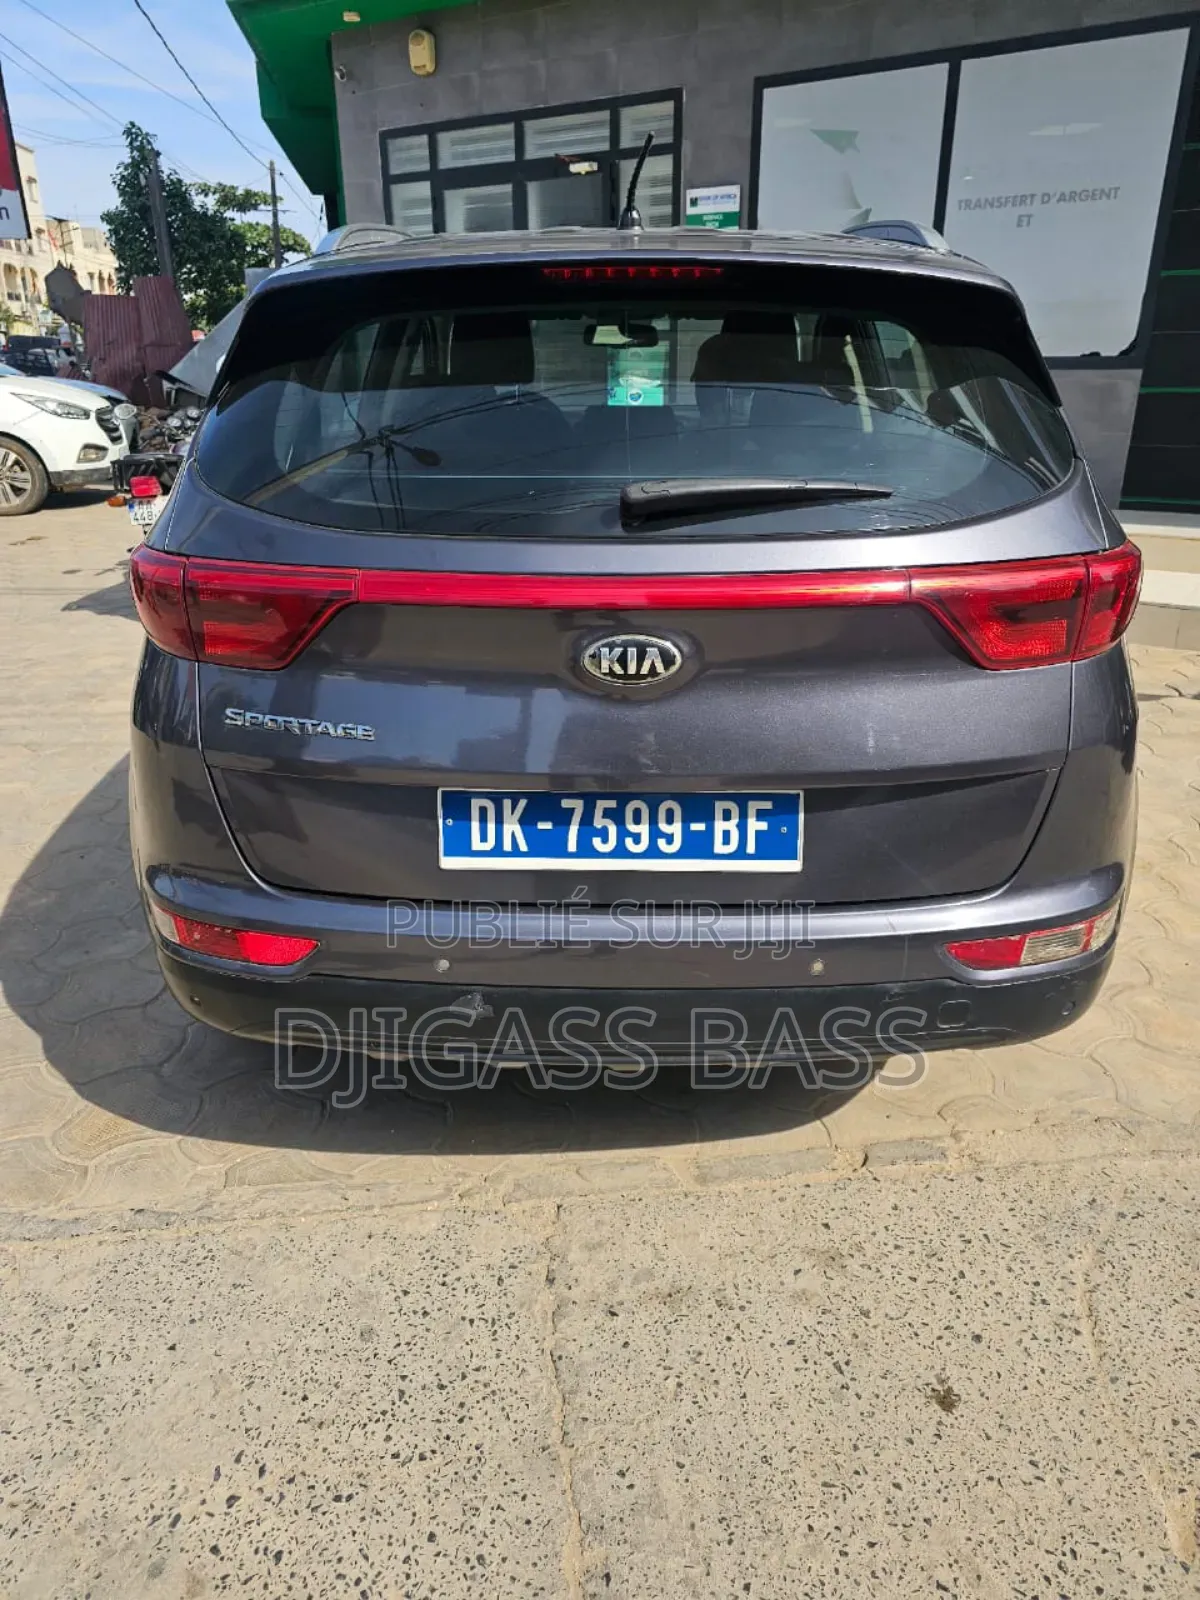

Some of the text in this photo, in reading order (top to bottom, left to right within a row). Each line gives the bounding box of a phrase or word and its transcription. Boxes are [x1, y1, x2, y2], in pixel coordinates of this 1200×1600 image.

[957, 186, 1121, 211] TRANSFERT D'ARGENT
[1016, 214, 1033, 228] ET
[600, 647, 665, 675] KIA
[224, 708, 375, 741] SPORTAGE
[470, 798, 773, 855] DK-7599-BF
